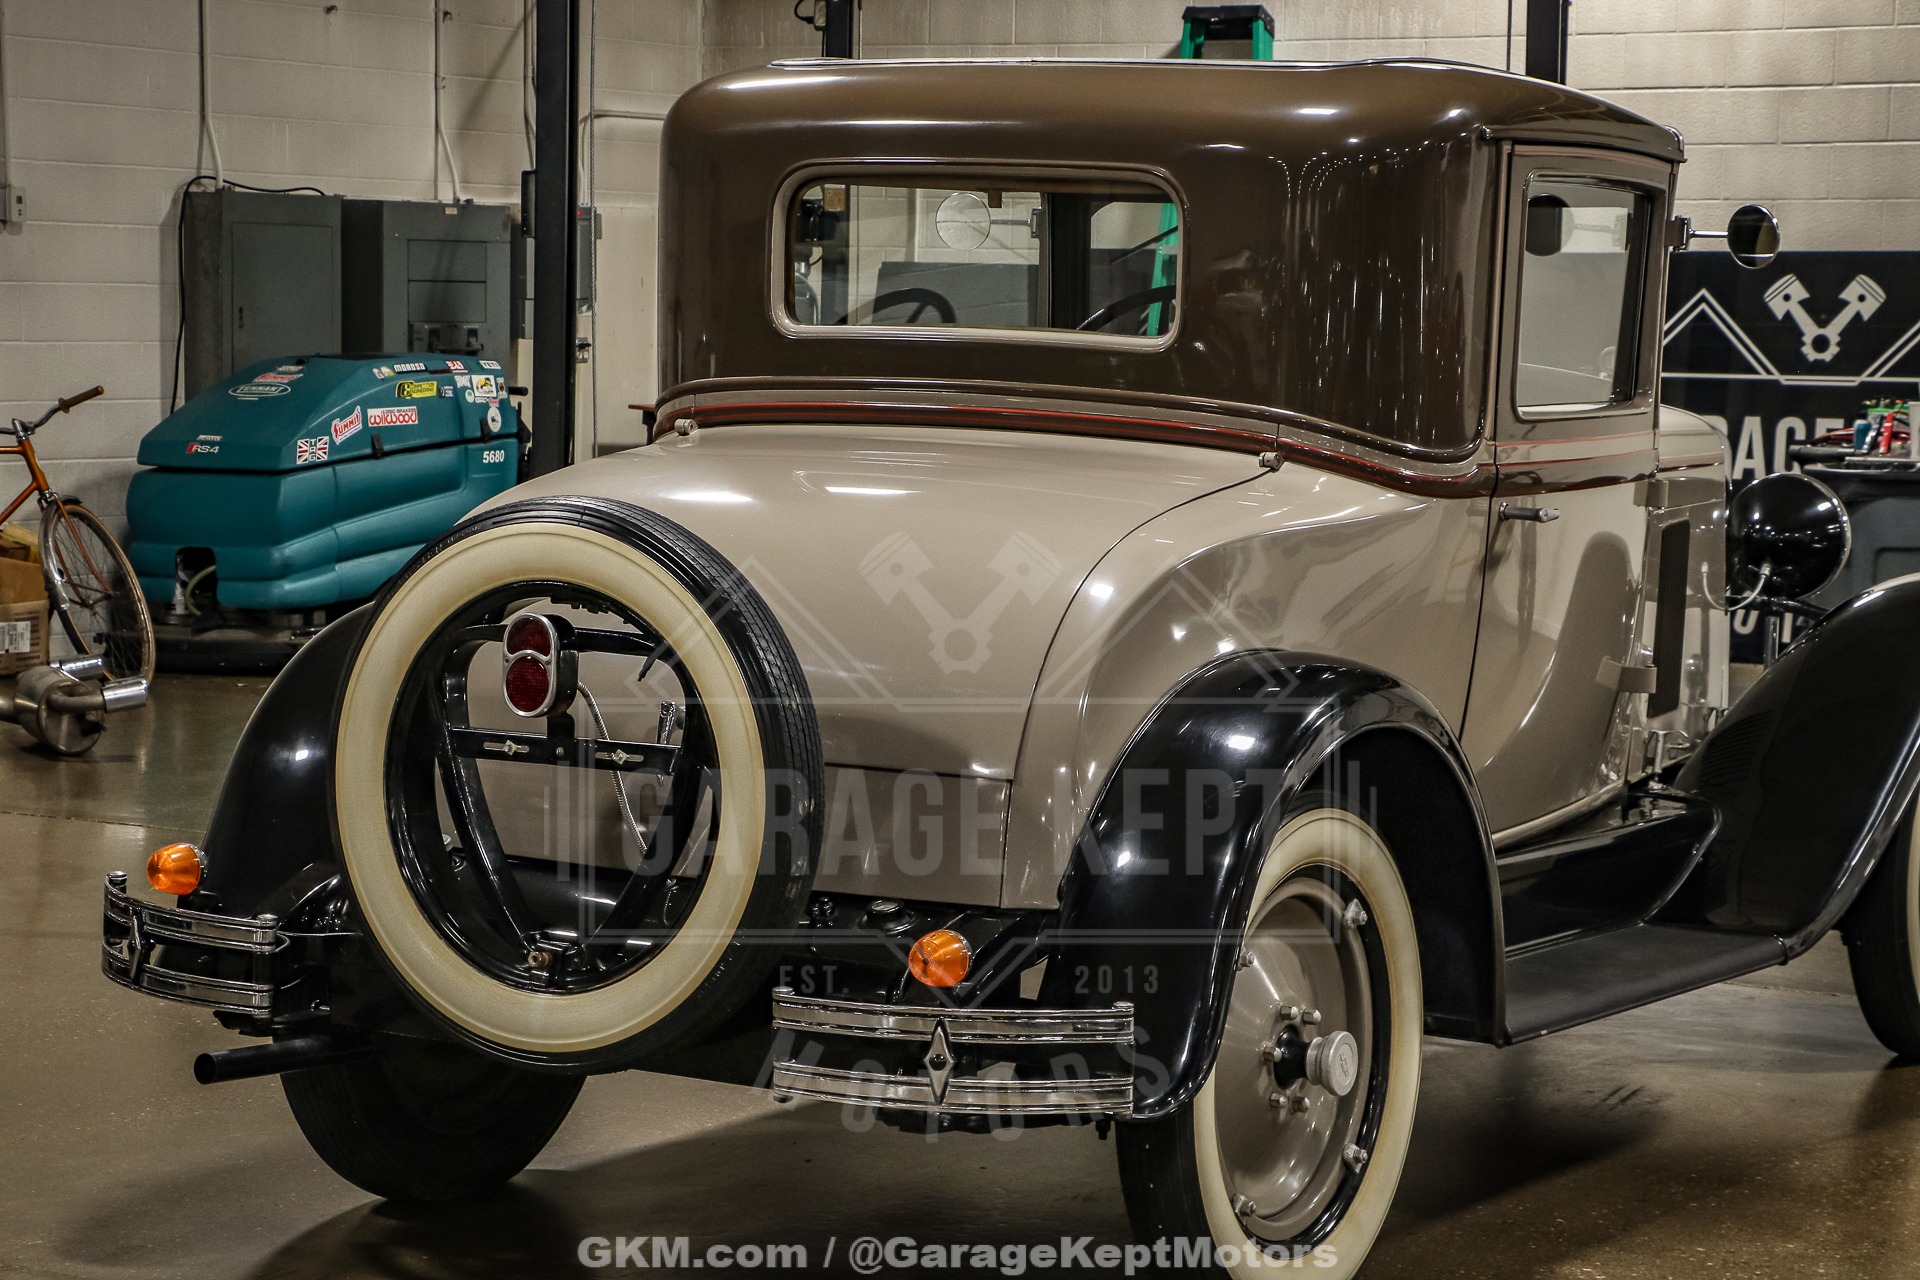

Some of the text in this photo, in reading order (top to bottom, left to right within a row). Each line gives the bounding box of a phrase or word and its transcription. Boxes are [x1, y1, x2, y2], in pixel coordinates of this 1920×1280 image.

[393, 363, 426, 373] MOROSO
[237, 386, 285, 394] TENNANT
[369, 409, 417, 426] wilwood
[333, 412, 360, 439] SUMMIT
[189, 444, 220, 454] RS4
[482, 449, 505, 463] 5680
